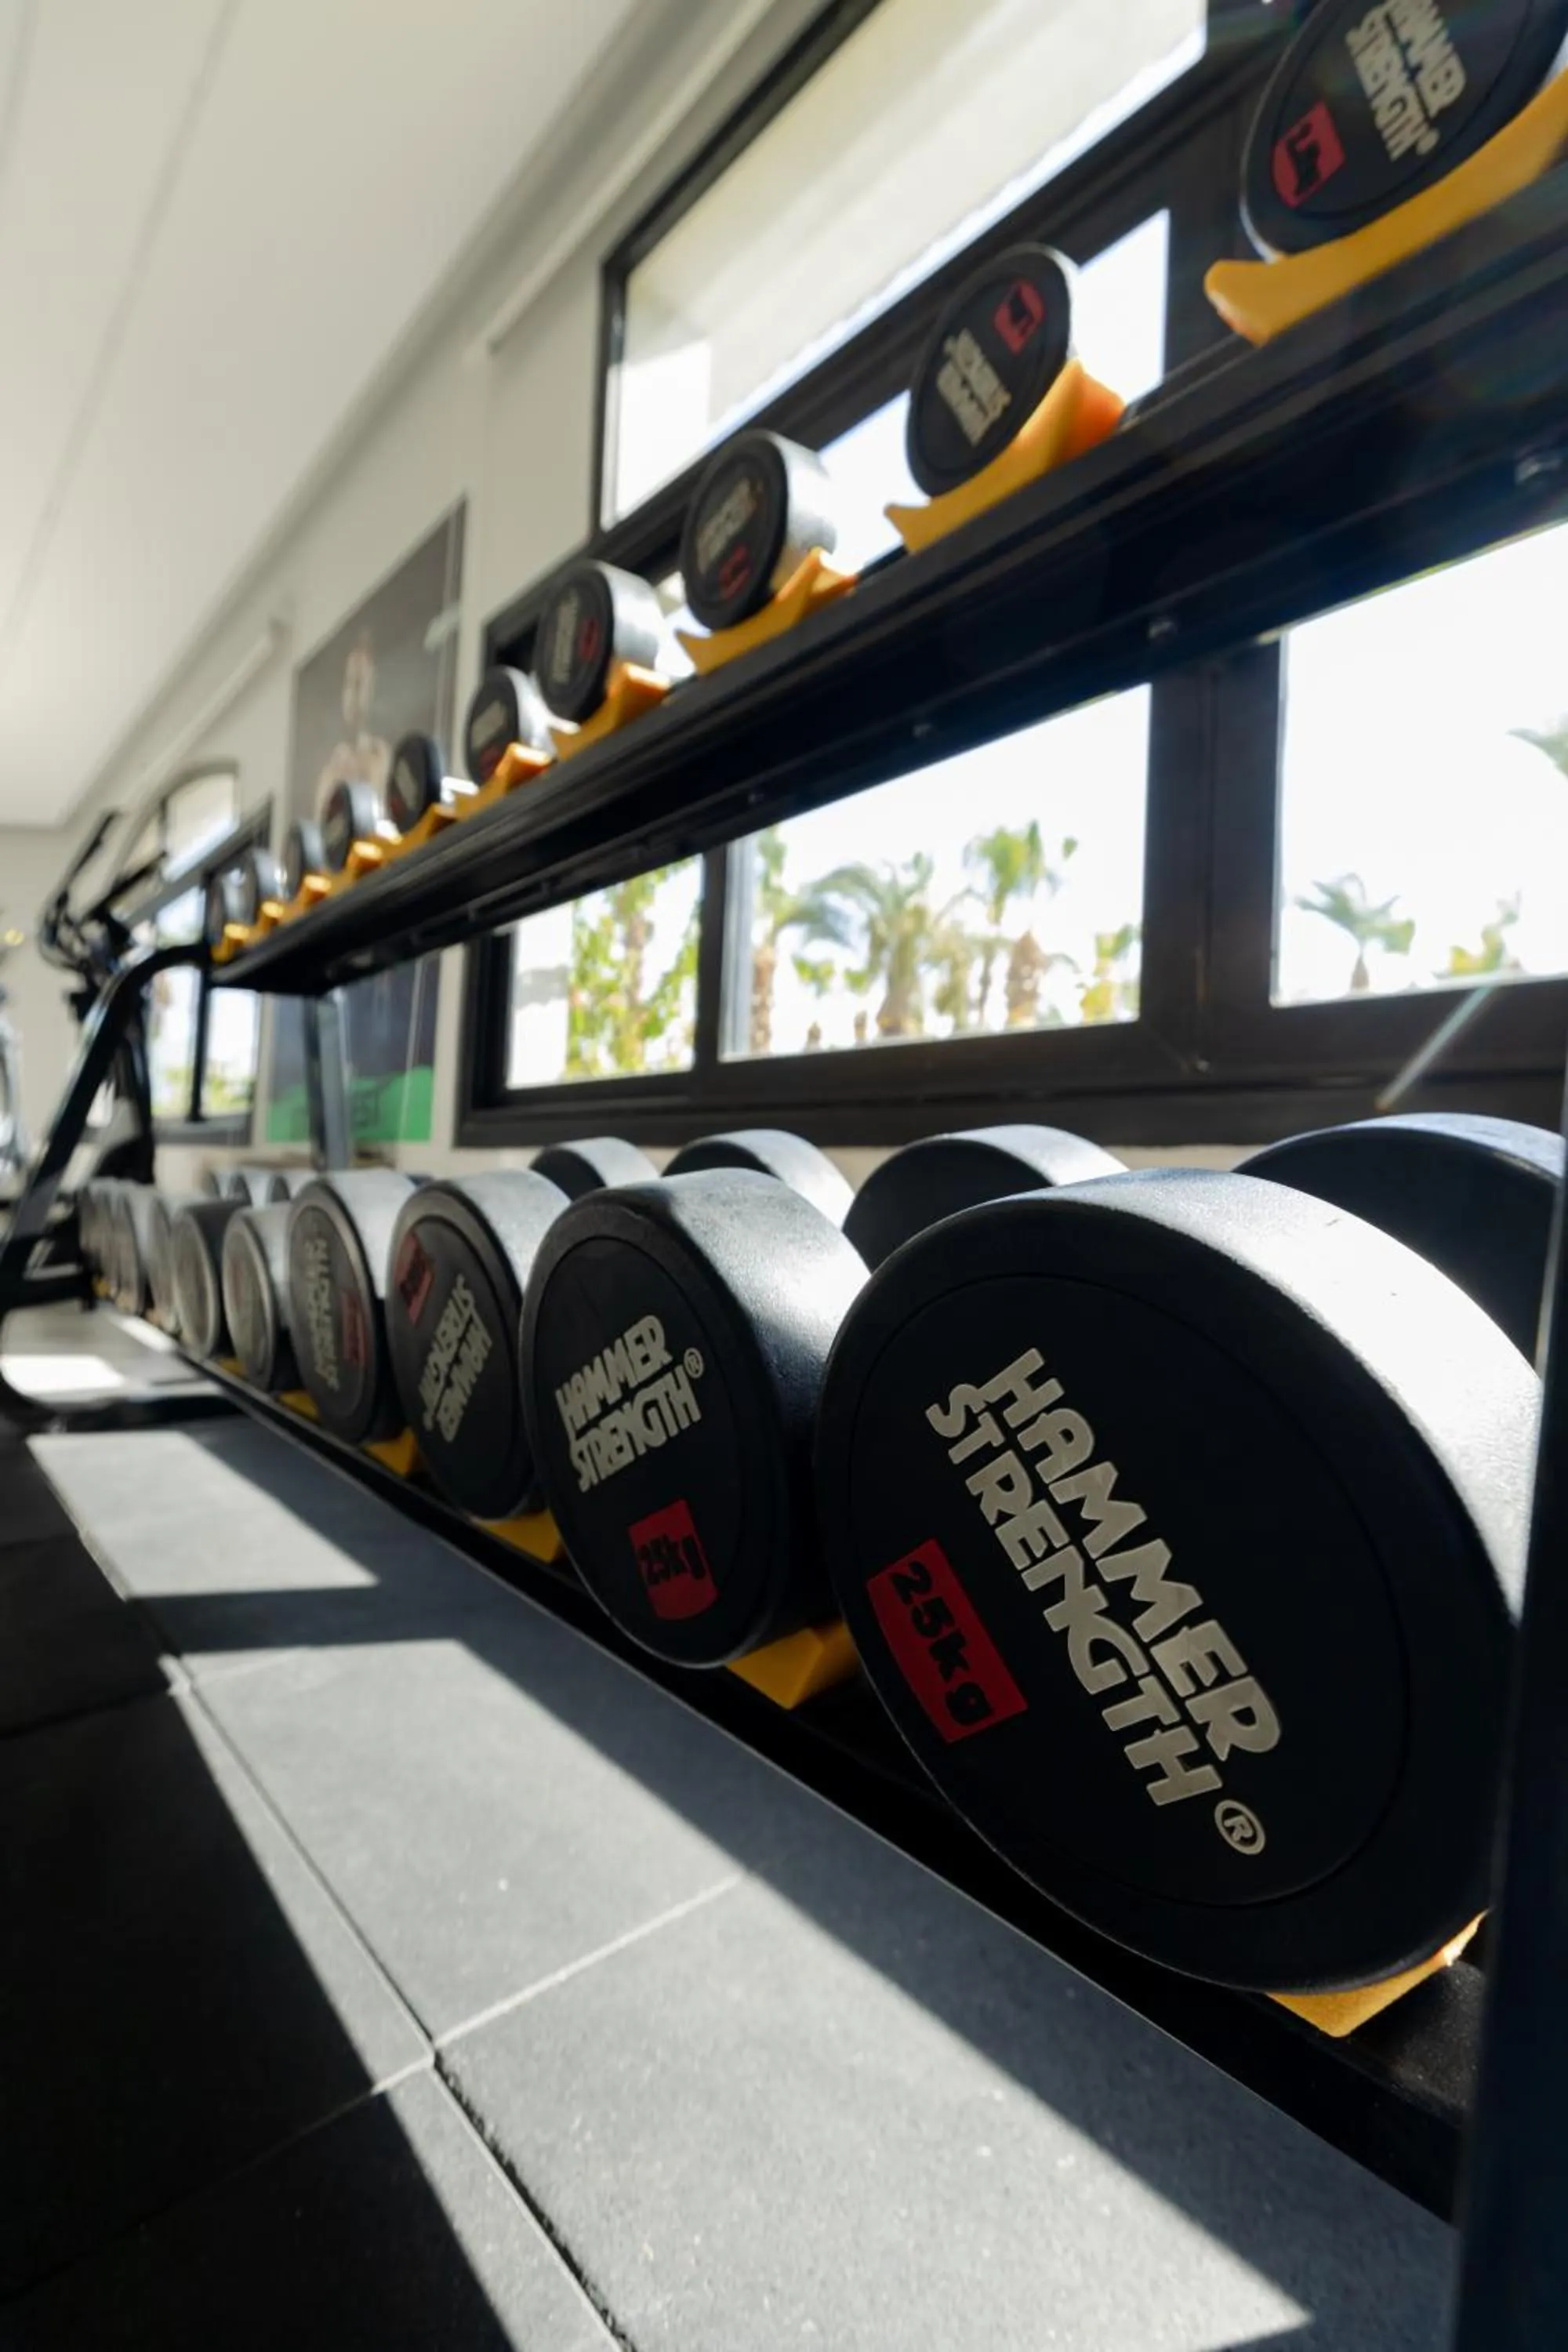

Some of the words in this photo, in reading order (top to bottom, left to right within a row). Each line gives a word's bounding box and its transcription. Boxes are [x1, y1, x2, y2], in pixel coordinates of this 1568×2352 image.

[555, 1315, 673, 1441] HAMMER
[981, 1348, 1281, 1762] HAMMER
[890, 1560, 995, 1726] 25kg
